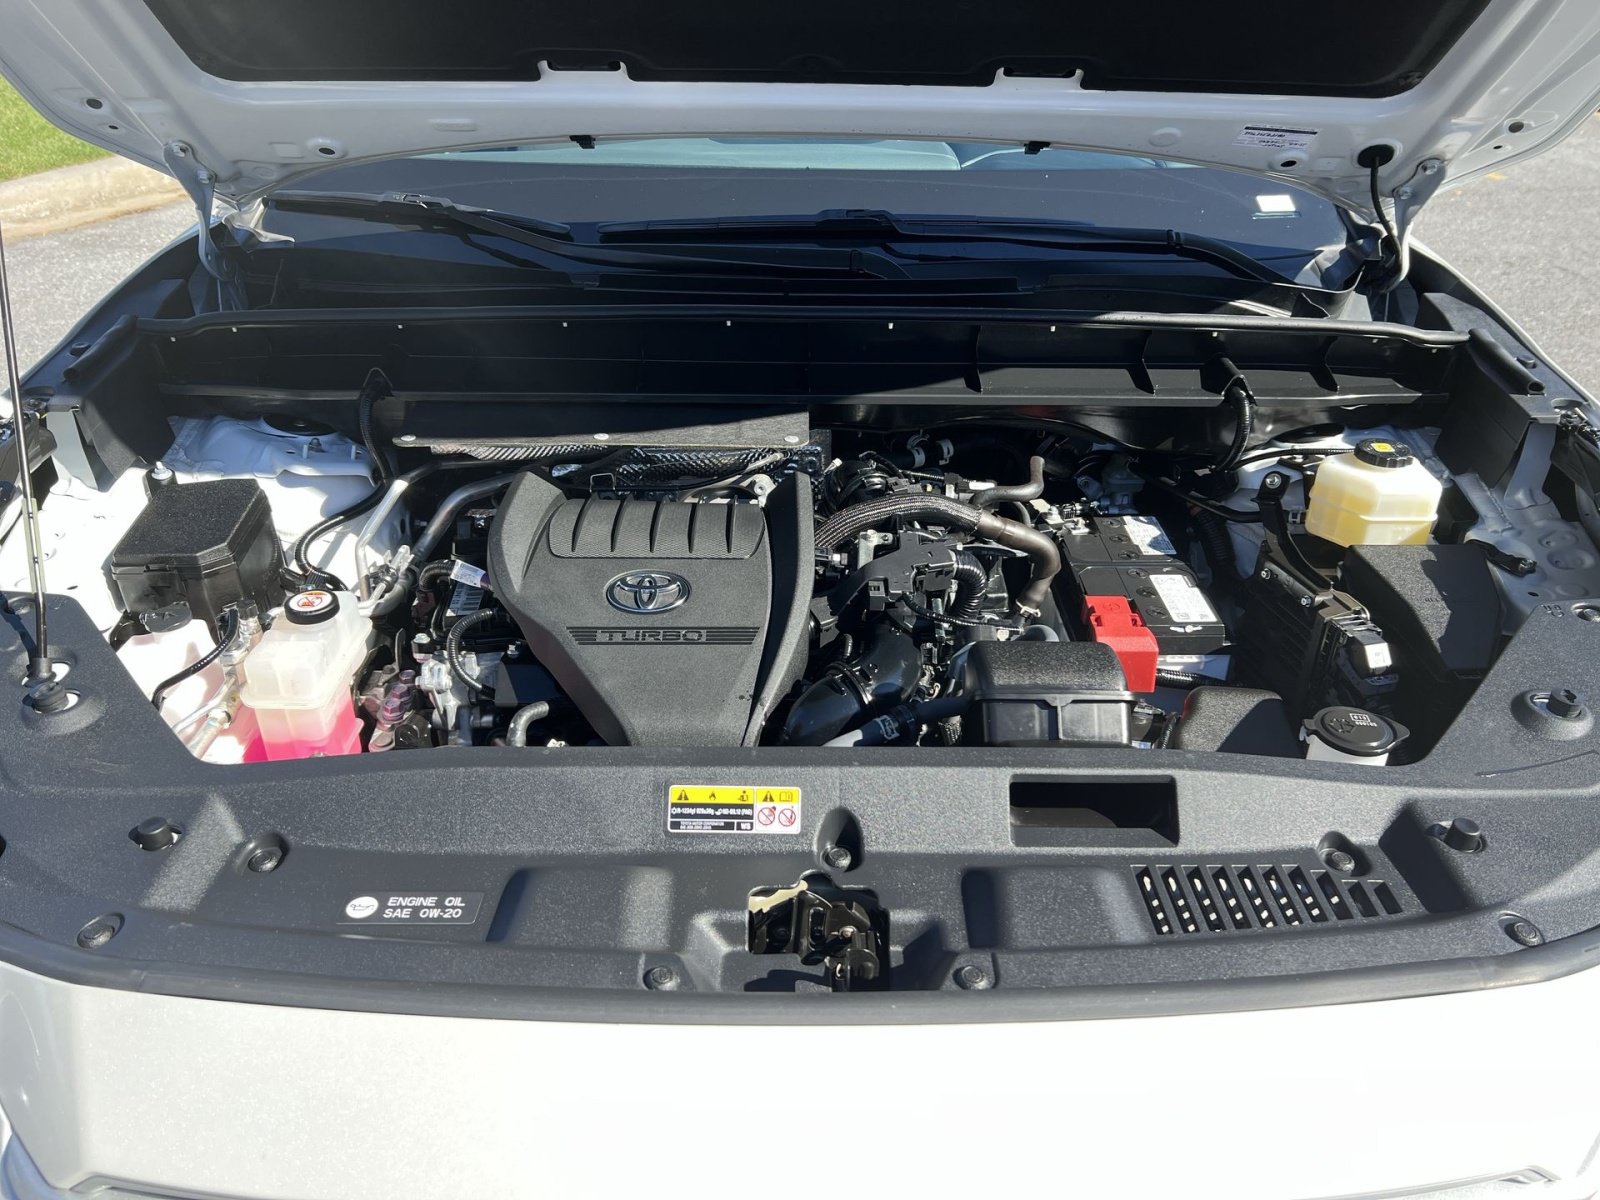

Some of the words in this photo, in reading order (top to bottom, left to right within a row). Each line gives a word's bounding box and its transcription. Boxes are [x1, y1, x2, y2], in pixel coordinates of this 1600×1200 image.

[600, 630, 703, 642] TURBO
[387, 896, 438, 907] ENGINE
[444, 896, 466, 907] OIL
[382, 908, 412, 919] SAE
[419, 908, 462, 919] 0W-20
